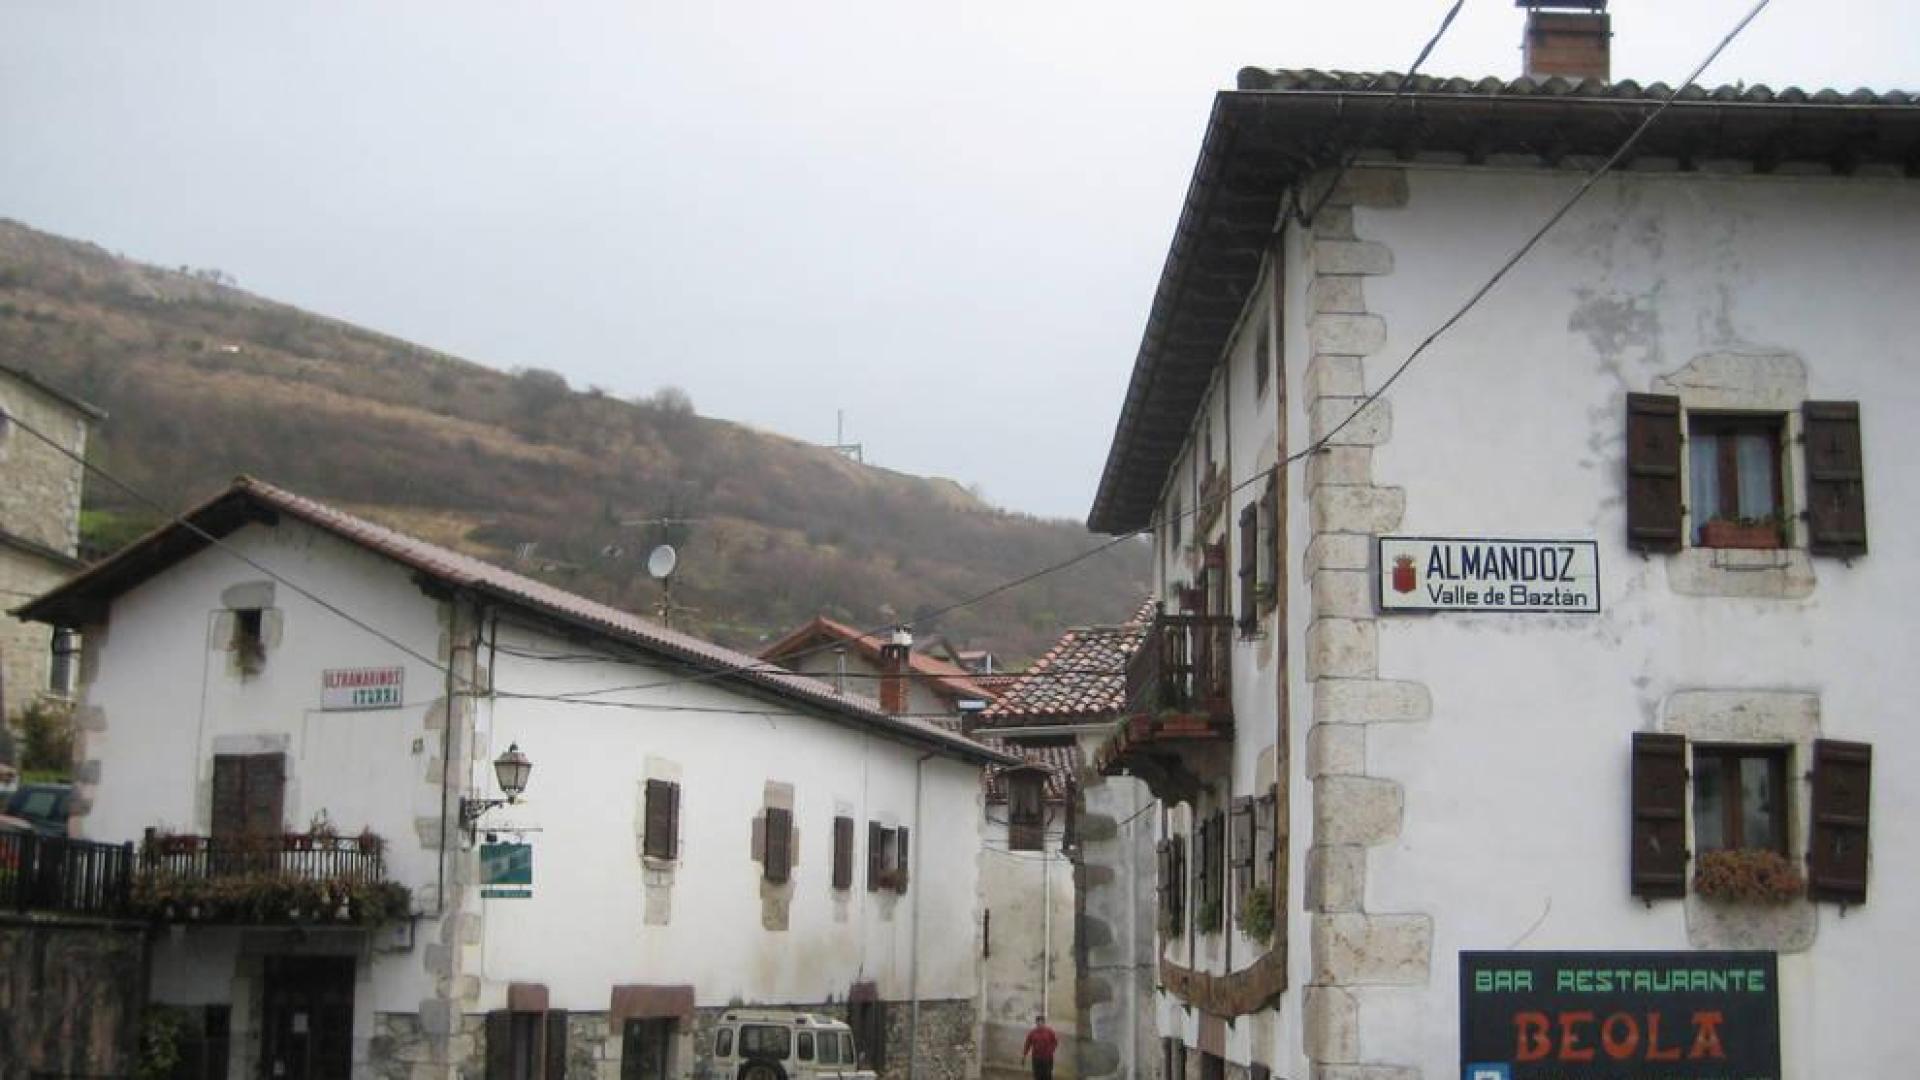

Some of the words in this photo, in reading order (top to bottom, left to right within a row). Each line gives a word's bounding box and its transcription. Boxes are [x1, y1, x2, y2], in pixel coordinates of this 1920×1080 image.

[1427, 544, 1576, 582] ALMANDOZ
[1427, 583, 1479, 605] Valle
[1483, 585, 1506, 605] de
[1510, 584, 1588, 606] Baztán
[1475, 969, 1533, 992] BAR
[1556, 969, 1766, 992] RESTAURANTE
[1513, 1010, 1726, 1061] BEOLA
